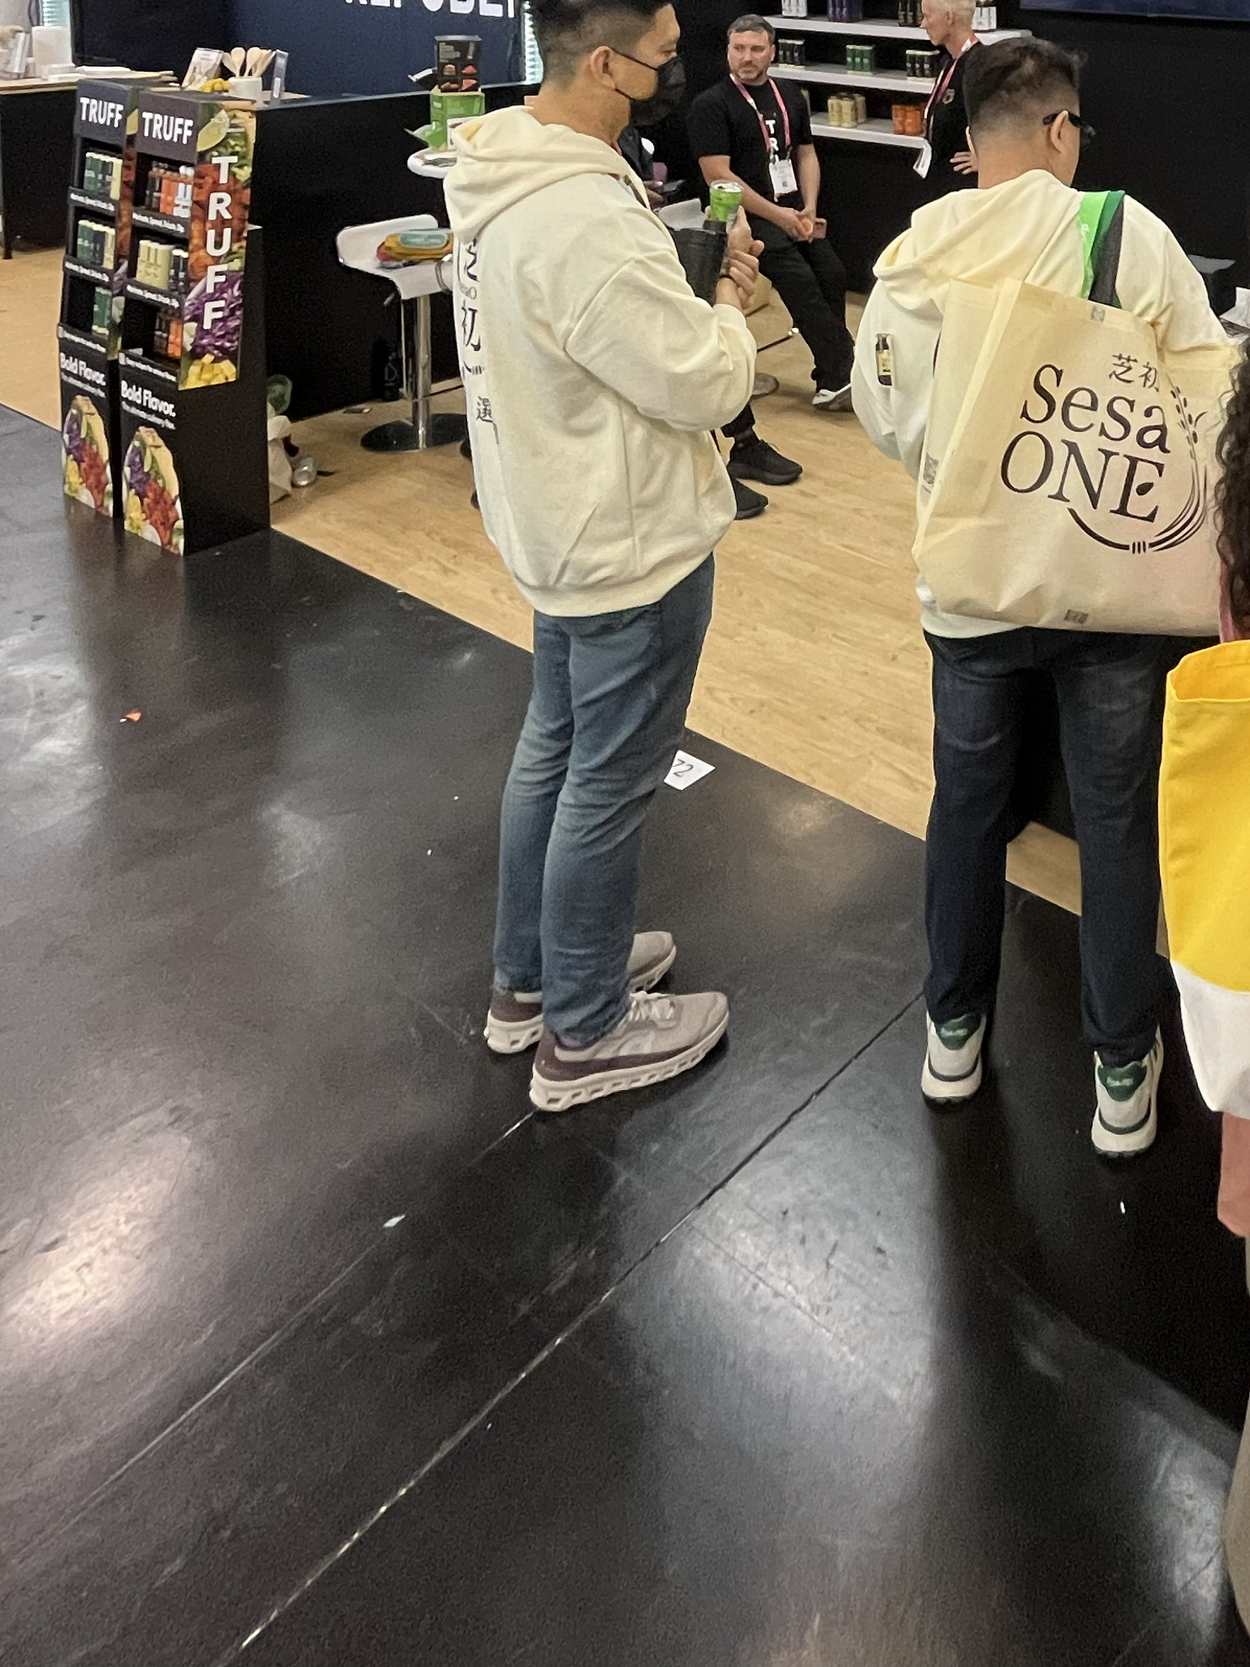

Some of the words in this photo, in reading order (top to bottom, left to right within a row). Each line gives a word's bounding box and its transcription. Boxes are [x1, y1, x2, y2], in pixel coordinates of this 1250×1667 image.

[79, 96, 125, 129] TRUFF
[142, 111, 194, 145] TRUFF
[203, 155, 239, 330] TRUFF
[60, 352, 79, 375] Bold
[79, 359, 107, 386] Flavor.
[121, 380, 143, 405] Bold
[142, 388, 177, 418] Flavor.
[1019, 363, 1171, 454] Sesa
[1000, 430, 1166, 523] ONE
